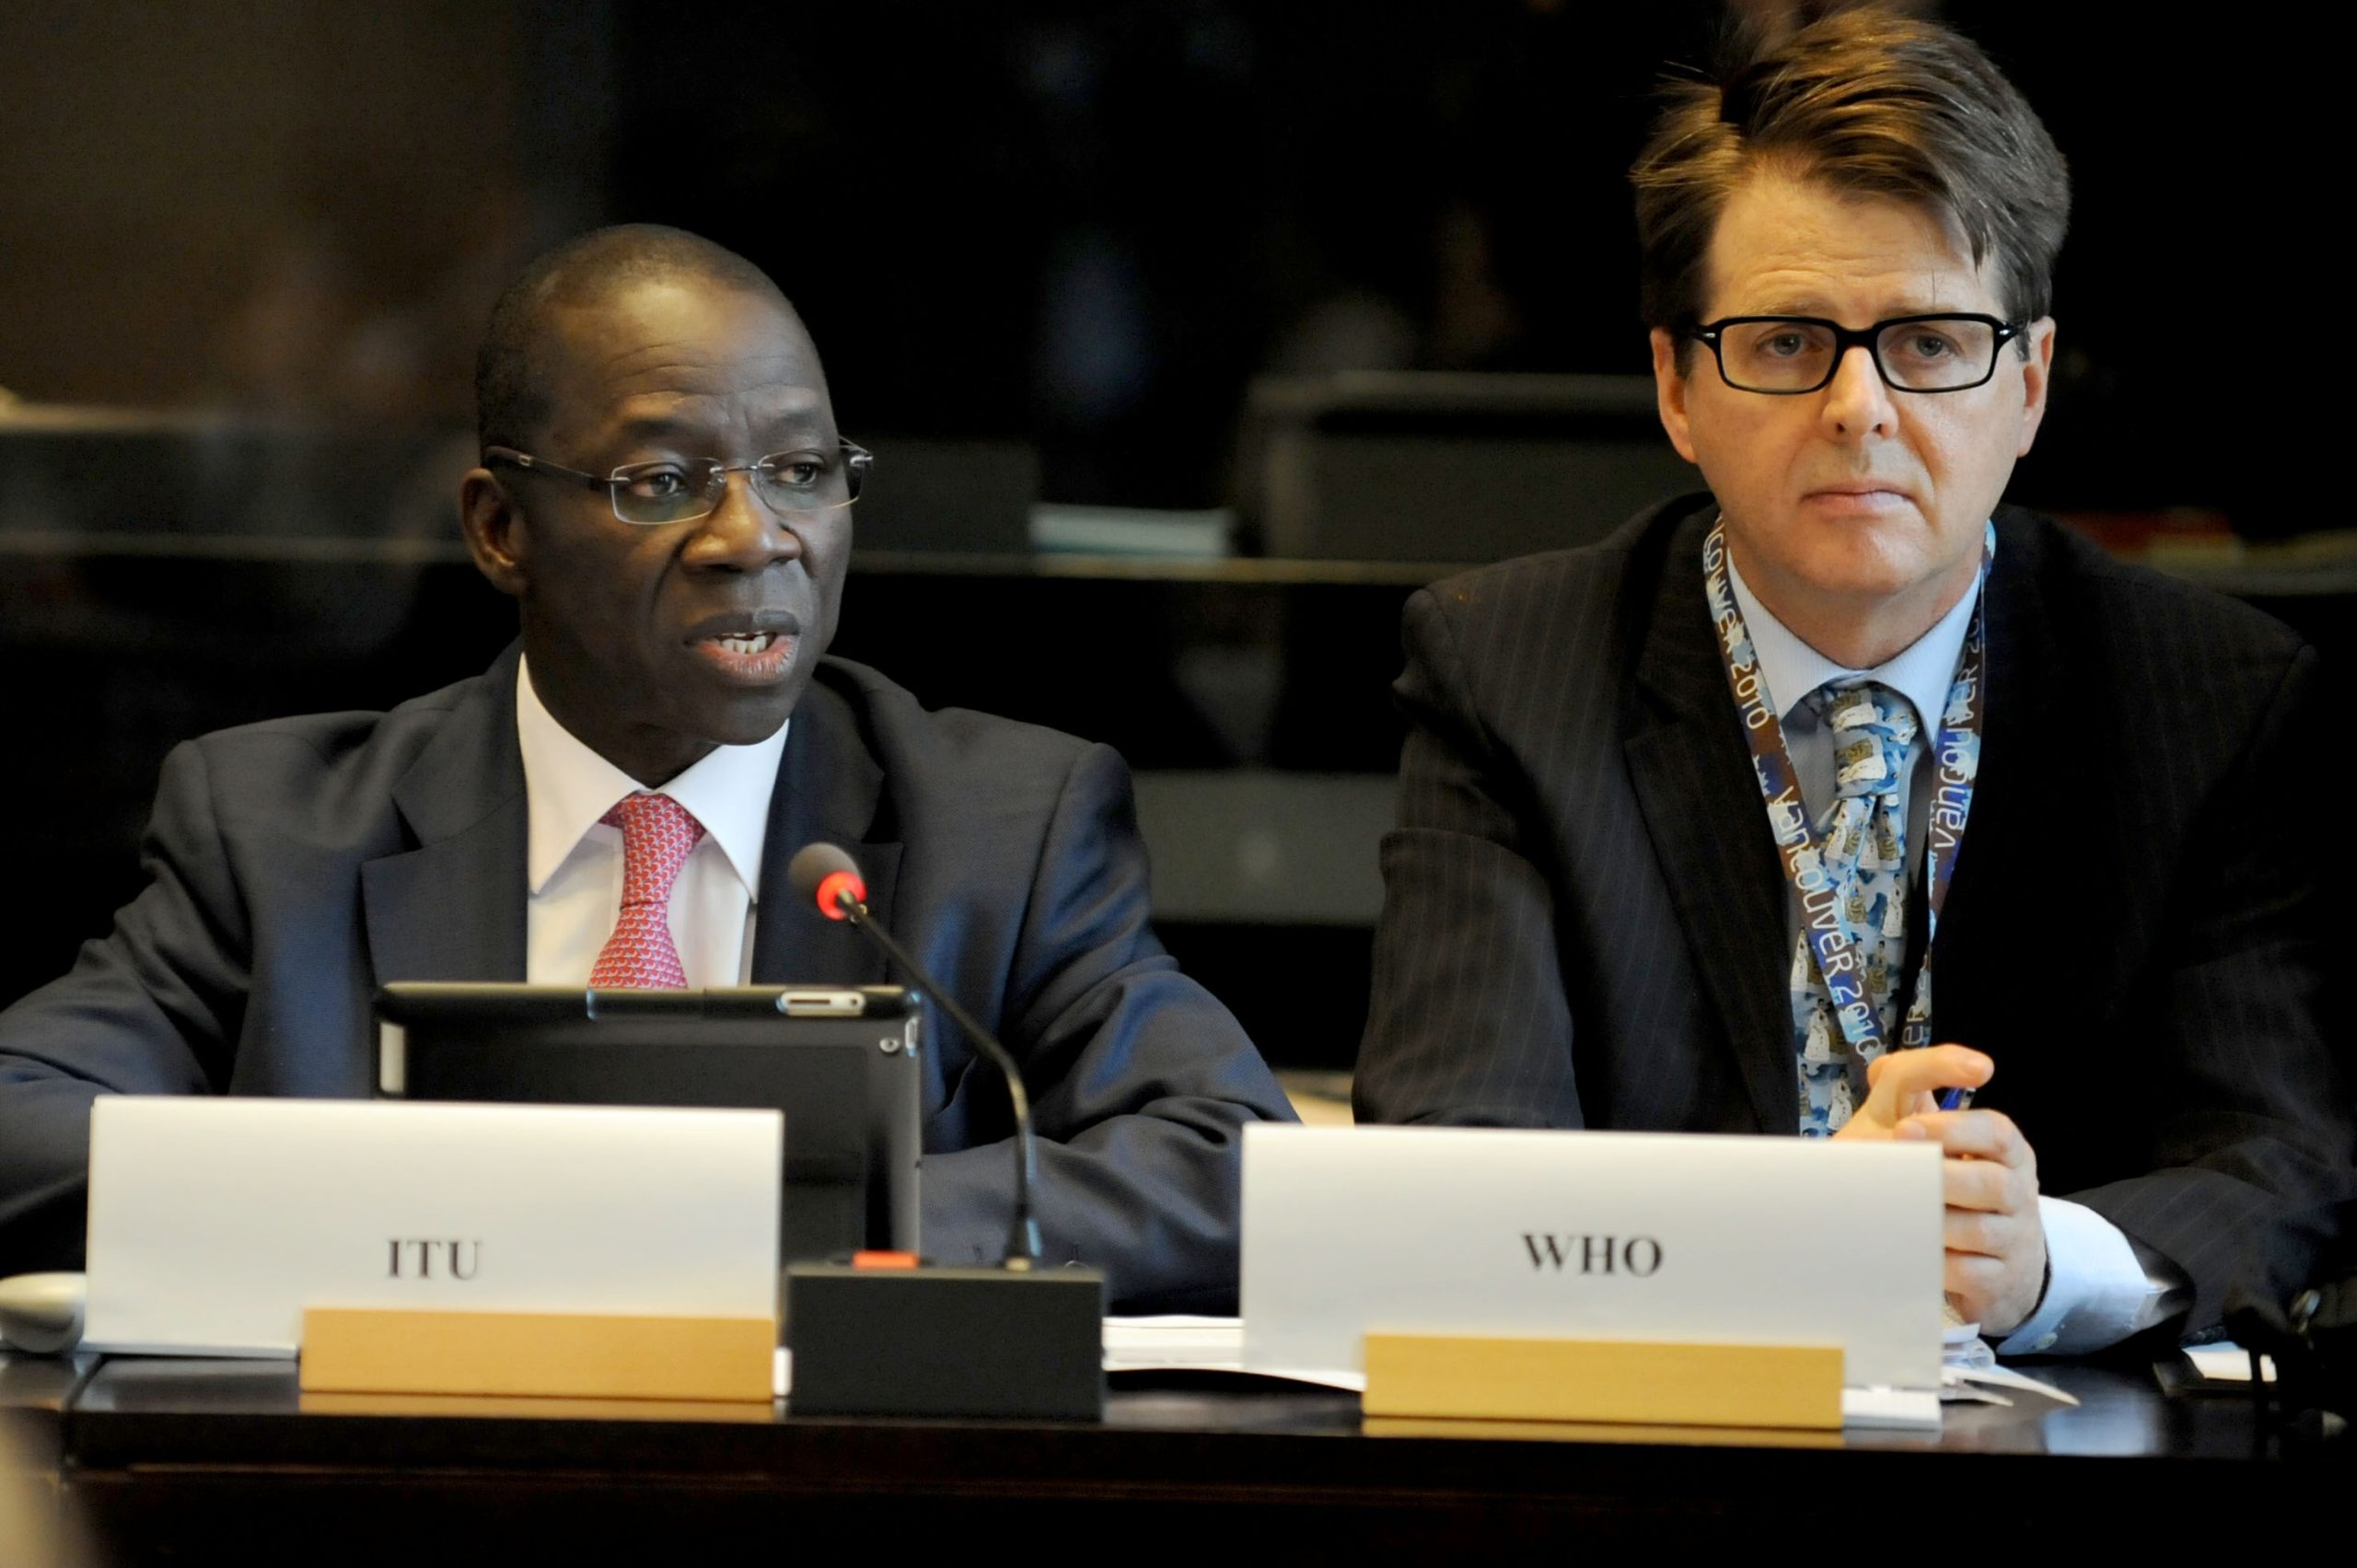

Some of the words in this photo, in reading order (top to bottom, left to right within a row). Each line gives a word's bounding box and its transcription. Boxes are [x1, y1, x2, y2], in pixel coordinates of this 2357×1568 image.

[1730, 656, 1770, 730] 2010
[1838, 981, 1881, 1056] 2010
[386, 1237, 483, 1281] ITU
[1521, 1233, 1663, 1278] WHO
